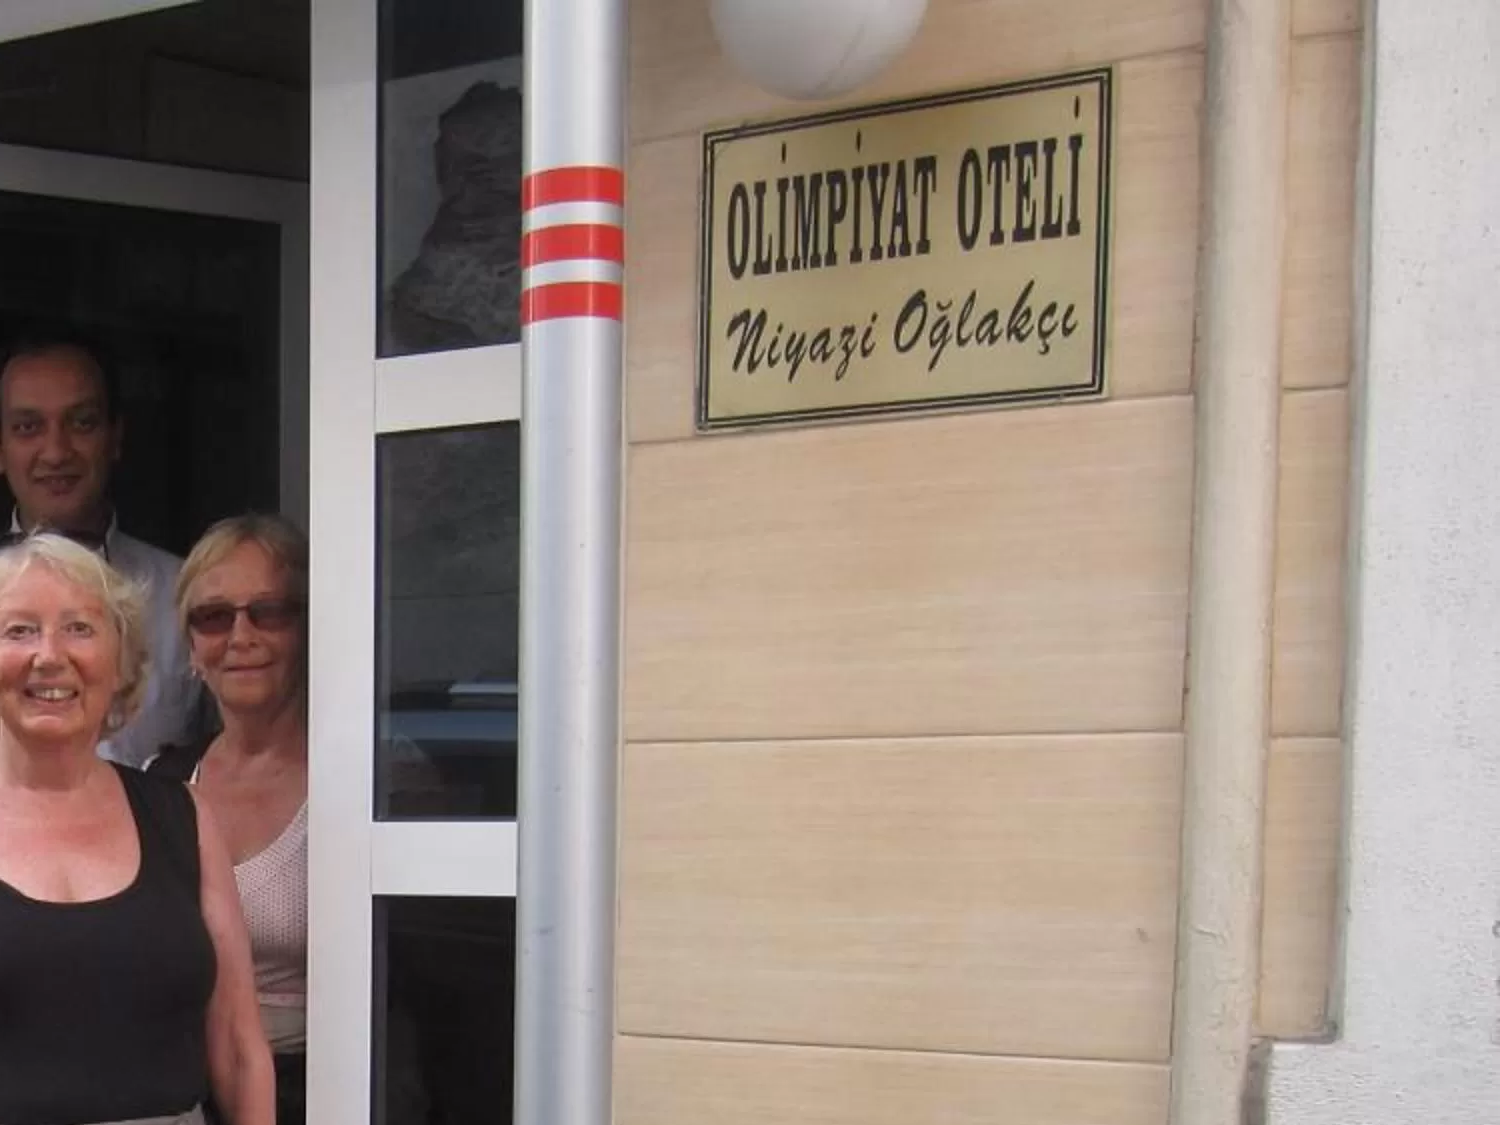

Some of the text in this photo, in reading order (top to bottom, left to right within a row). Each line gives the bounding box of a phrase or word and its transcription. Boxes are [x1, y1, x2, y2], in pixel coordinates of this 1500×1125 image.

[727, 95, 1084, 280] OLİMPİYAT OTELİ
[726, 279, 1080, 383] Niyazi Oğlakçı
